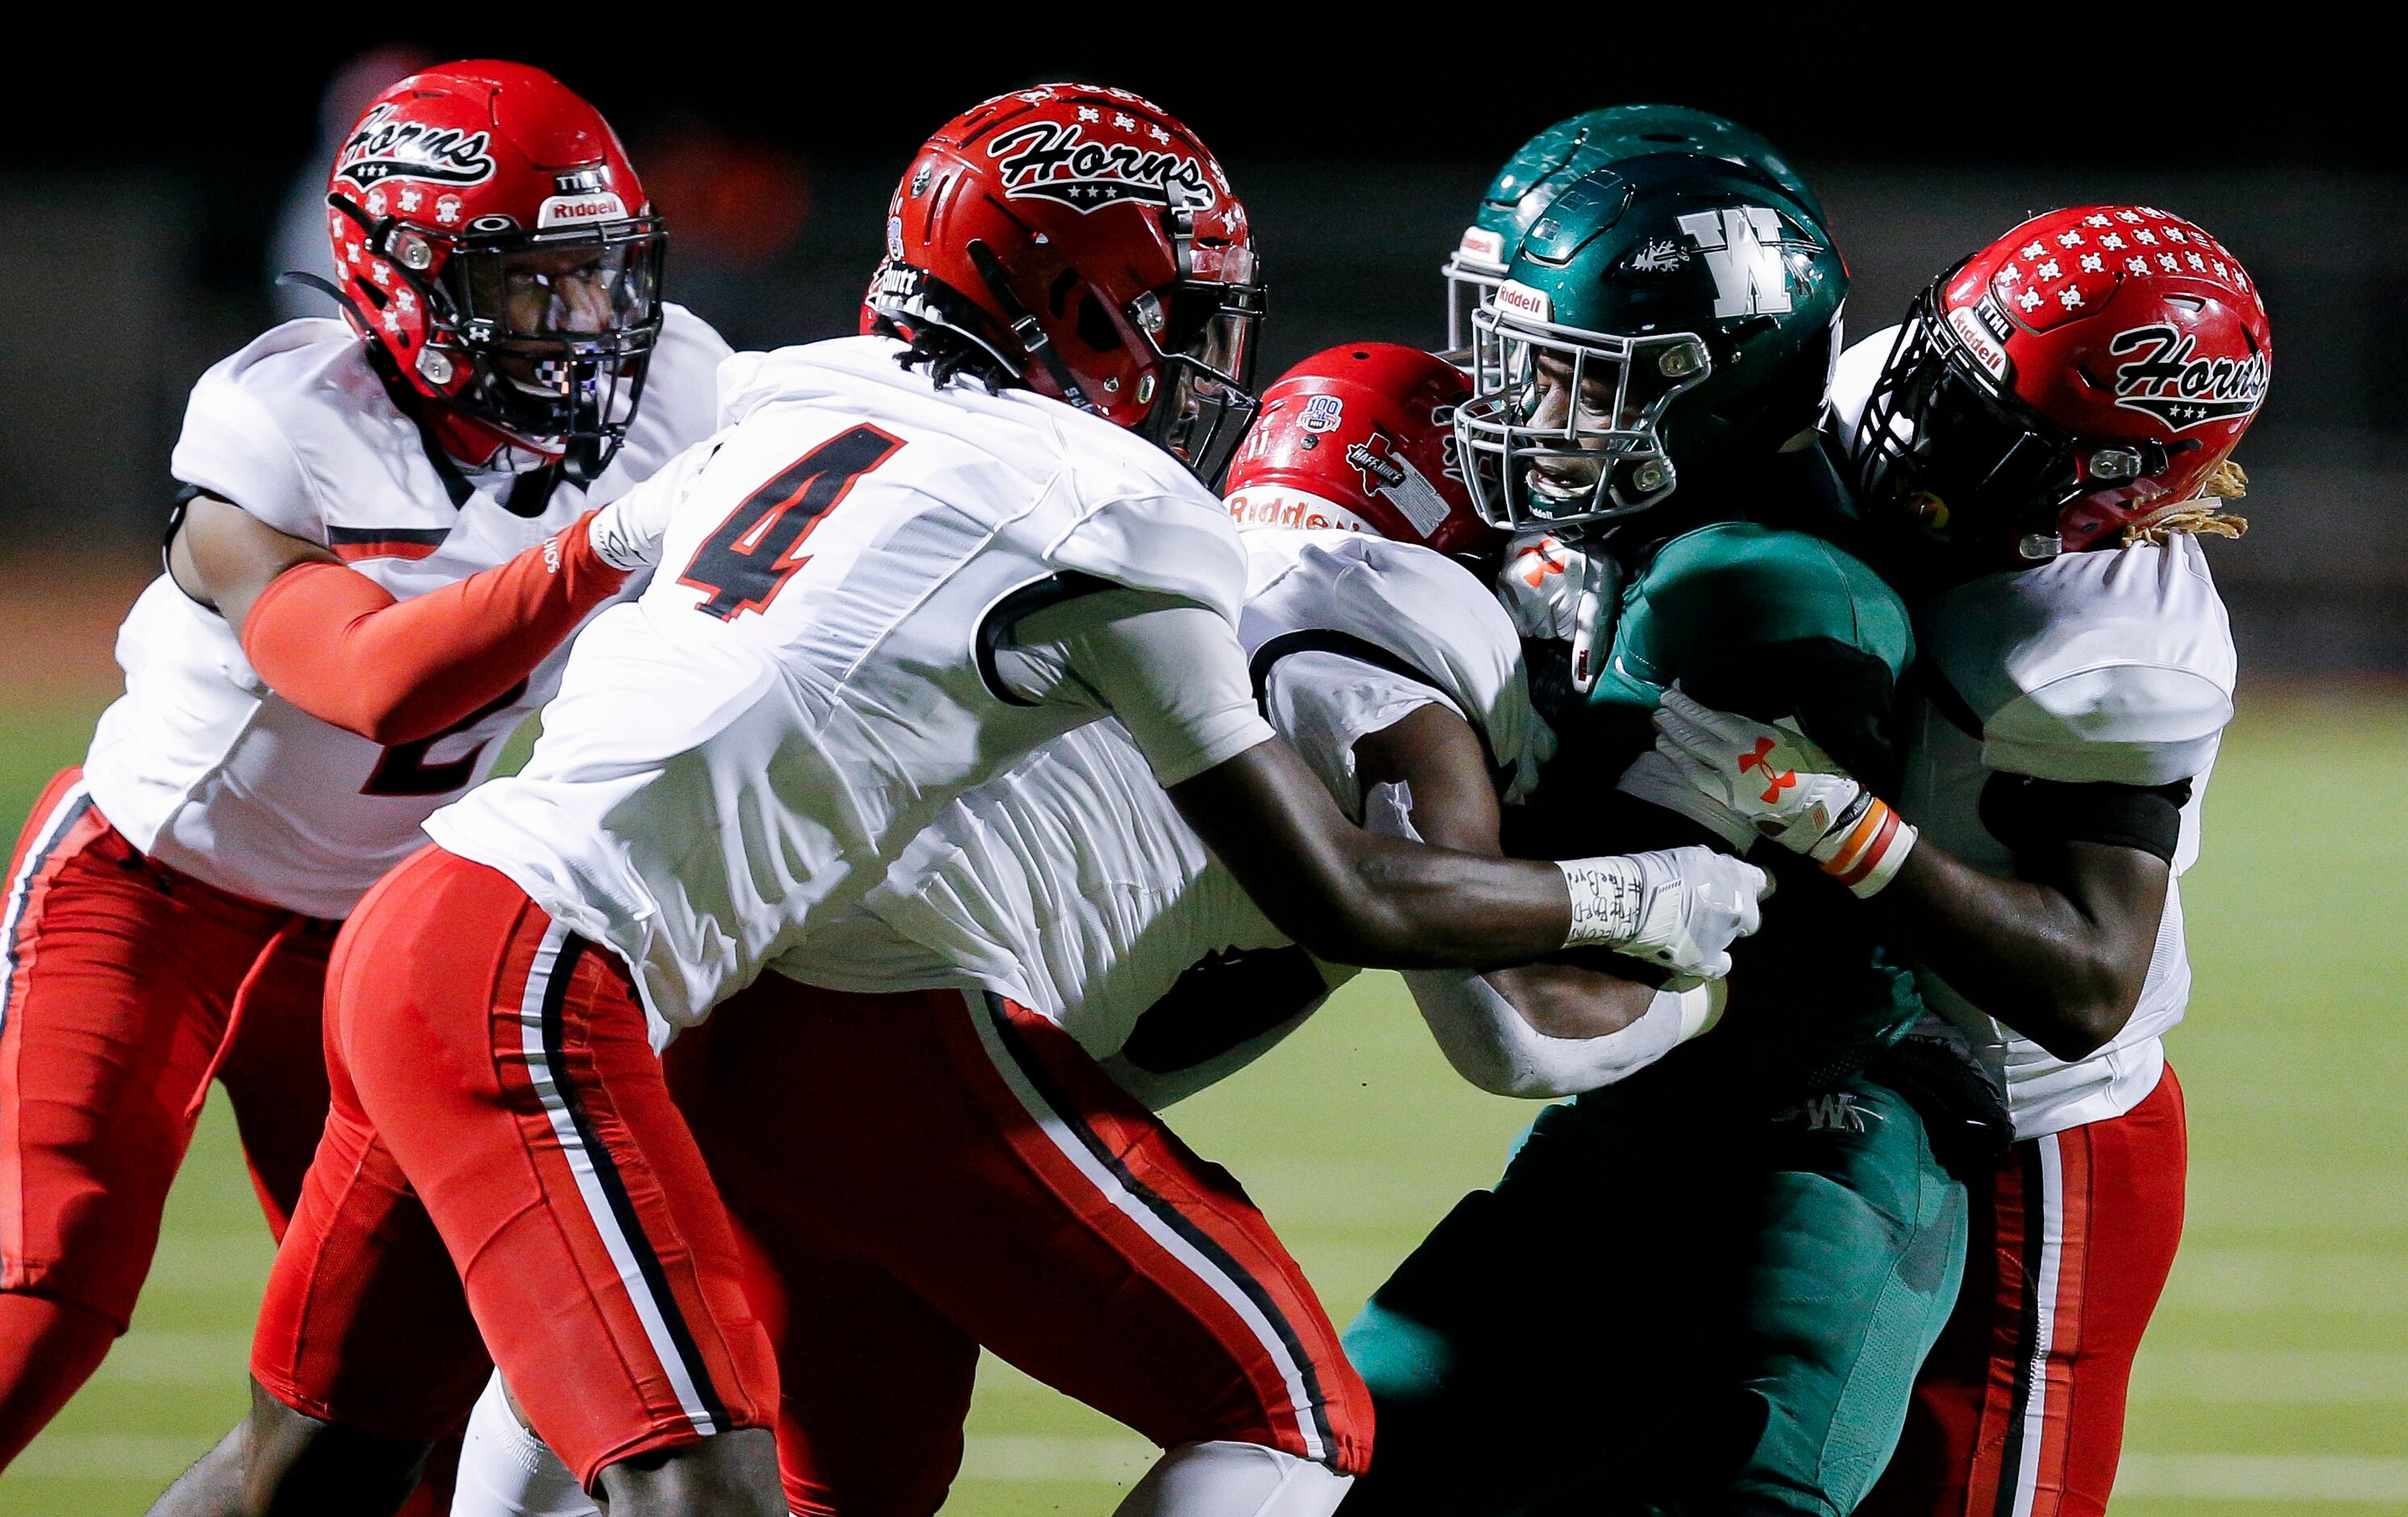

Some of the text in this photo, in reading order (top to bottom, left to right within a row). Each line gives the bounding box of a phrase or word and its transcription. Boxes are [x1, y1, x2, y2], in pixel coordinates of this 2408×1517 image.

[337, 102, 491, 168] Horns
[987, 120, 1214, 192] Horns
[554, 200, 618, 219] Riddell
[1674, 204, 1791, 318] W
[1499, 286, 1542, 313] Riddell
[1953, 311, 2003, 370] Riddell
[676, 422, 909, 623] 4
